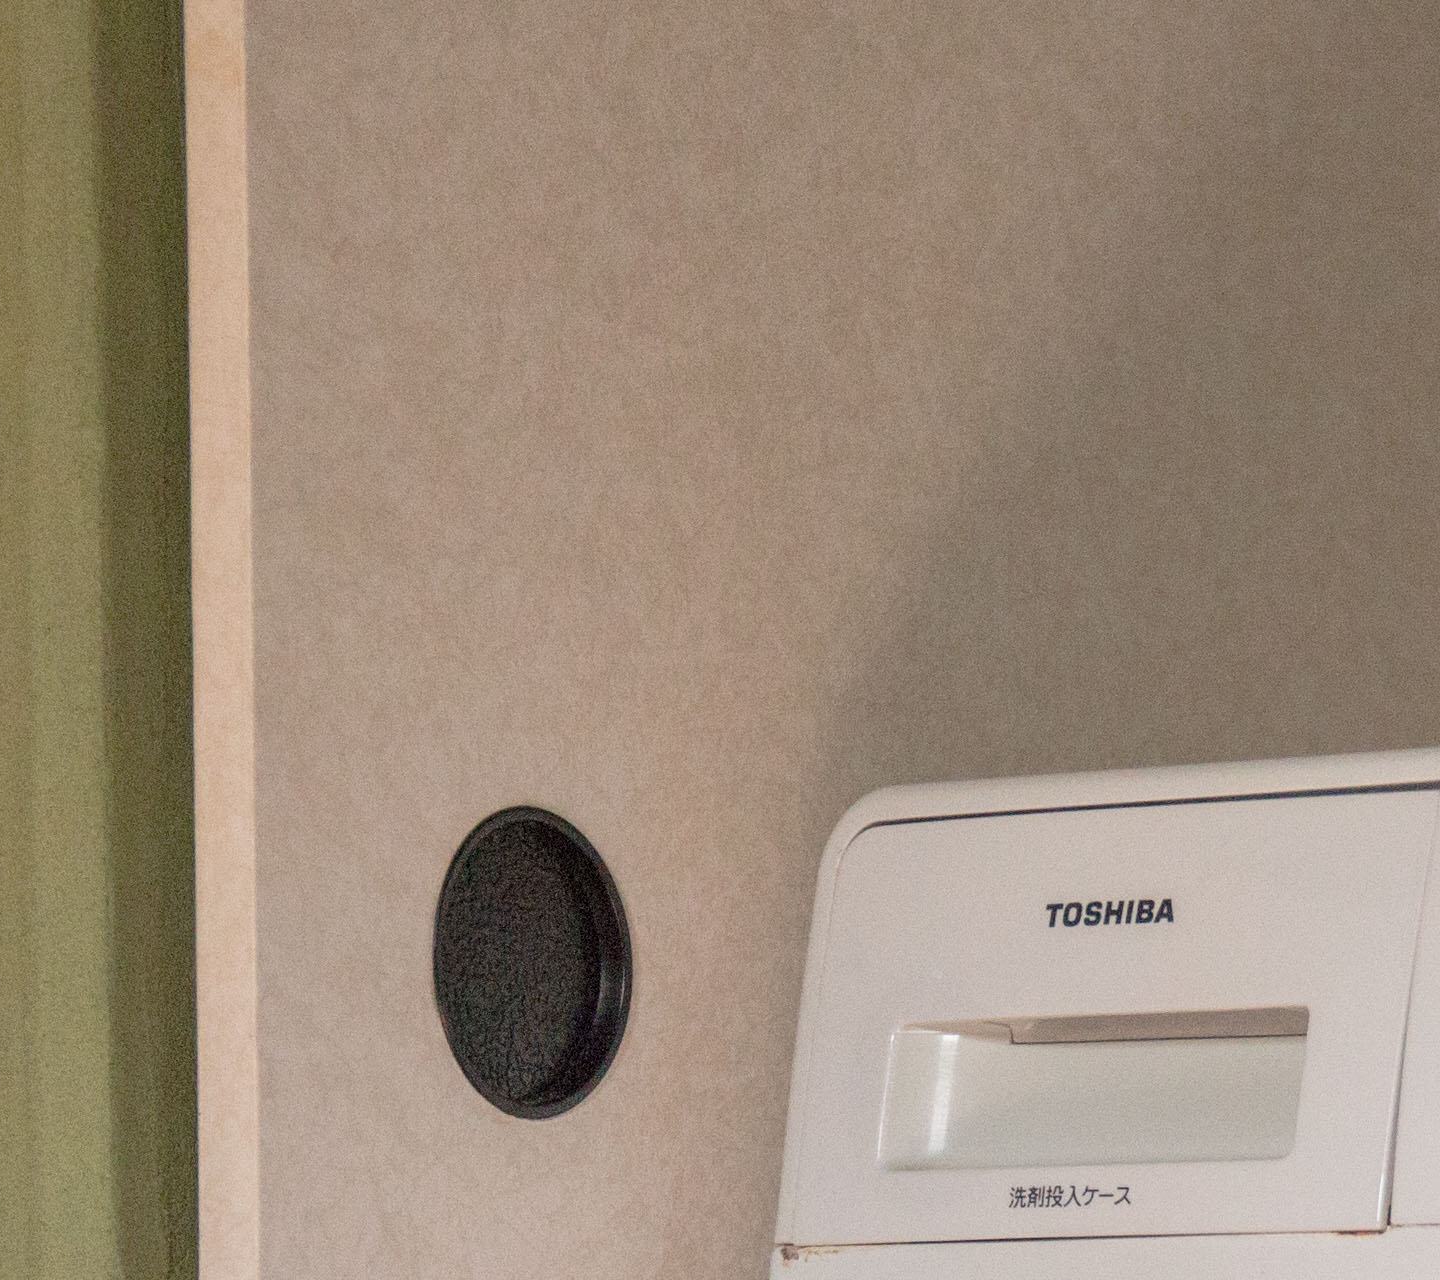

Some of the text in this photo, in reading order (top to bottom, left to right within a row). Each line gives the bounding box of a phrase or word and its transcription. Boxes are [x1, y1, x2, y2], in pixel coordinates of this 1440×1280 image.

[1045, 898, 1176, 928] TOSHIBA
[1008, 1184, 1133, 1208] 洗剤投入ケース
